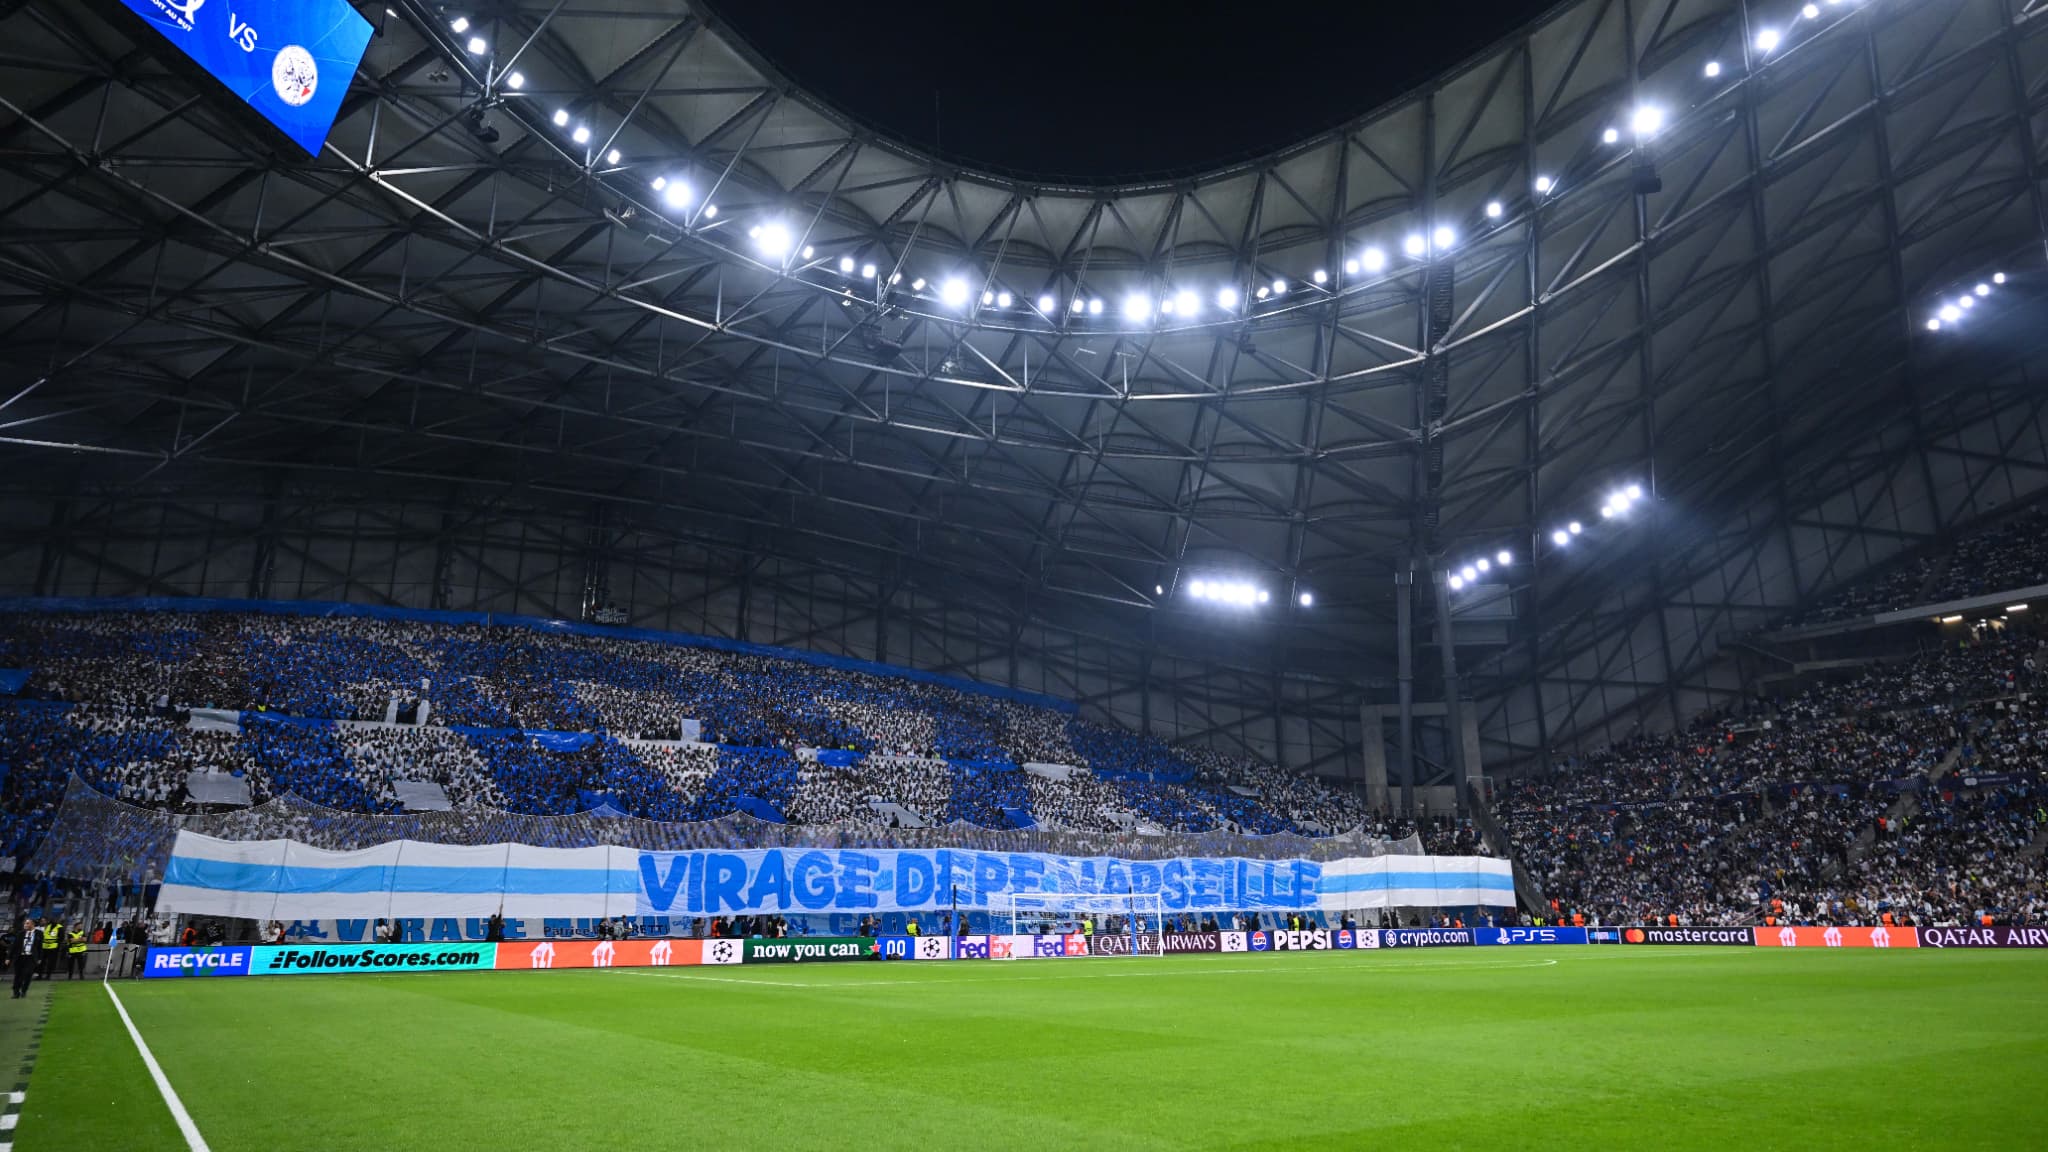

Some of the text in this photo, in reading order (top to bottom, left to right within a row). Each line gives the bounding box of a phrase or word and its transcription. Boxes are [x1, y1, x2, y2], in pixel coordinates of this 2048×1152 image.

[165, 8, 178, 20] AU
[177, 17, 193, 32] BUT
[229, 12, 258, 53] VS
[638, 849, 880, 913] VIRAGE
[544, 925, 590, 937] Patrice
[1274, 930, 1332, 951] PEPSI
[1400, 930, 1469, 947] crypto.com
[1511, 929, 1556, 942] PS5
[1648, 928, 1749, 943] mastercard
[1924, 928, 1998, 948] QATAR
[753, 943, 860, 960] now you can
[956, 935, 1013, 958] FedEx
[1033, 934, 1088, 956] FedEx
[1100, 933, 1217, 955] QATAR AIRWAYS
[154, 953, 244, 968] RECYCLE
[282, 949, 480, 969] FollowScores.com
